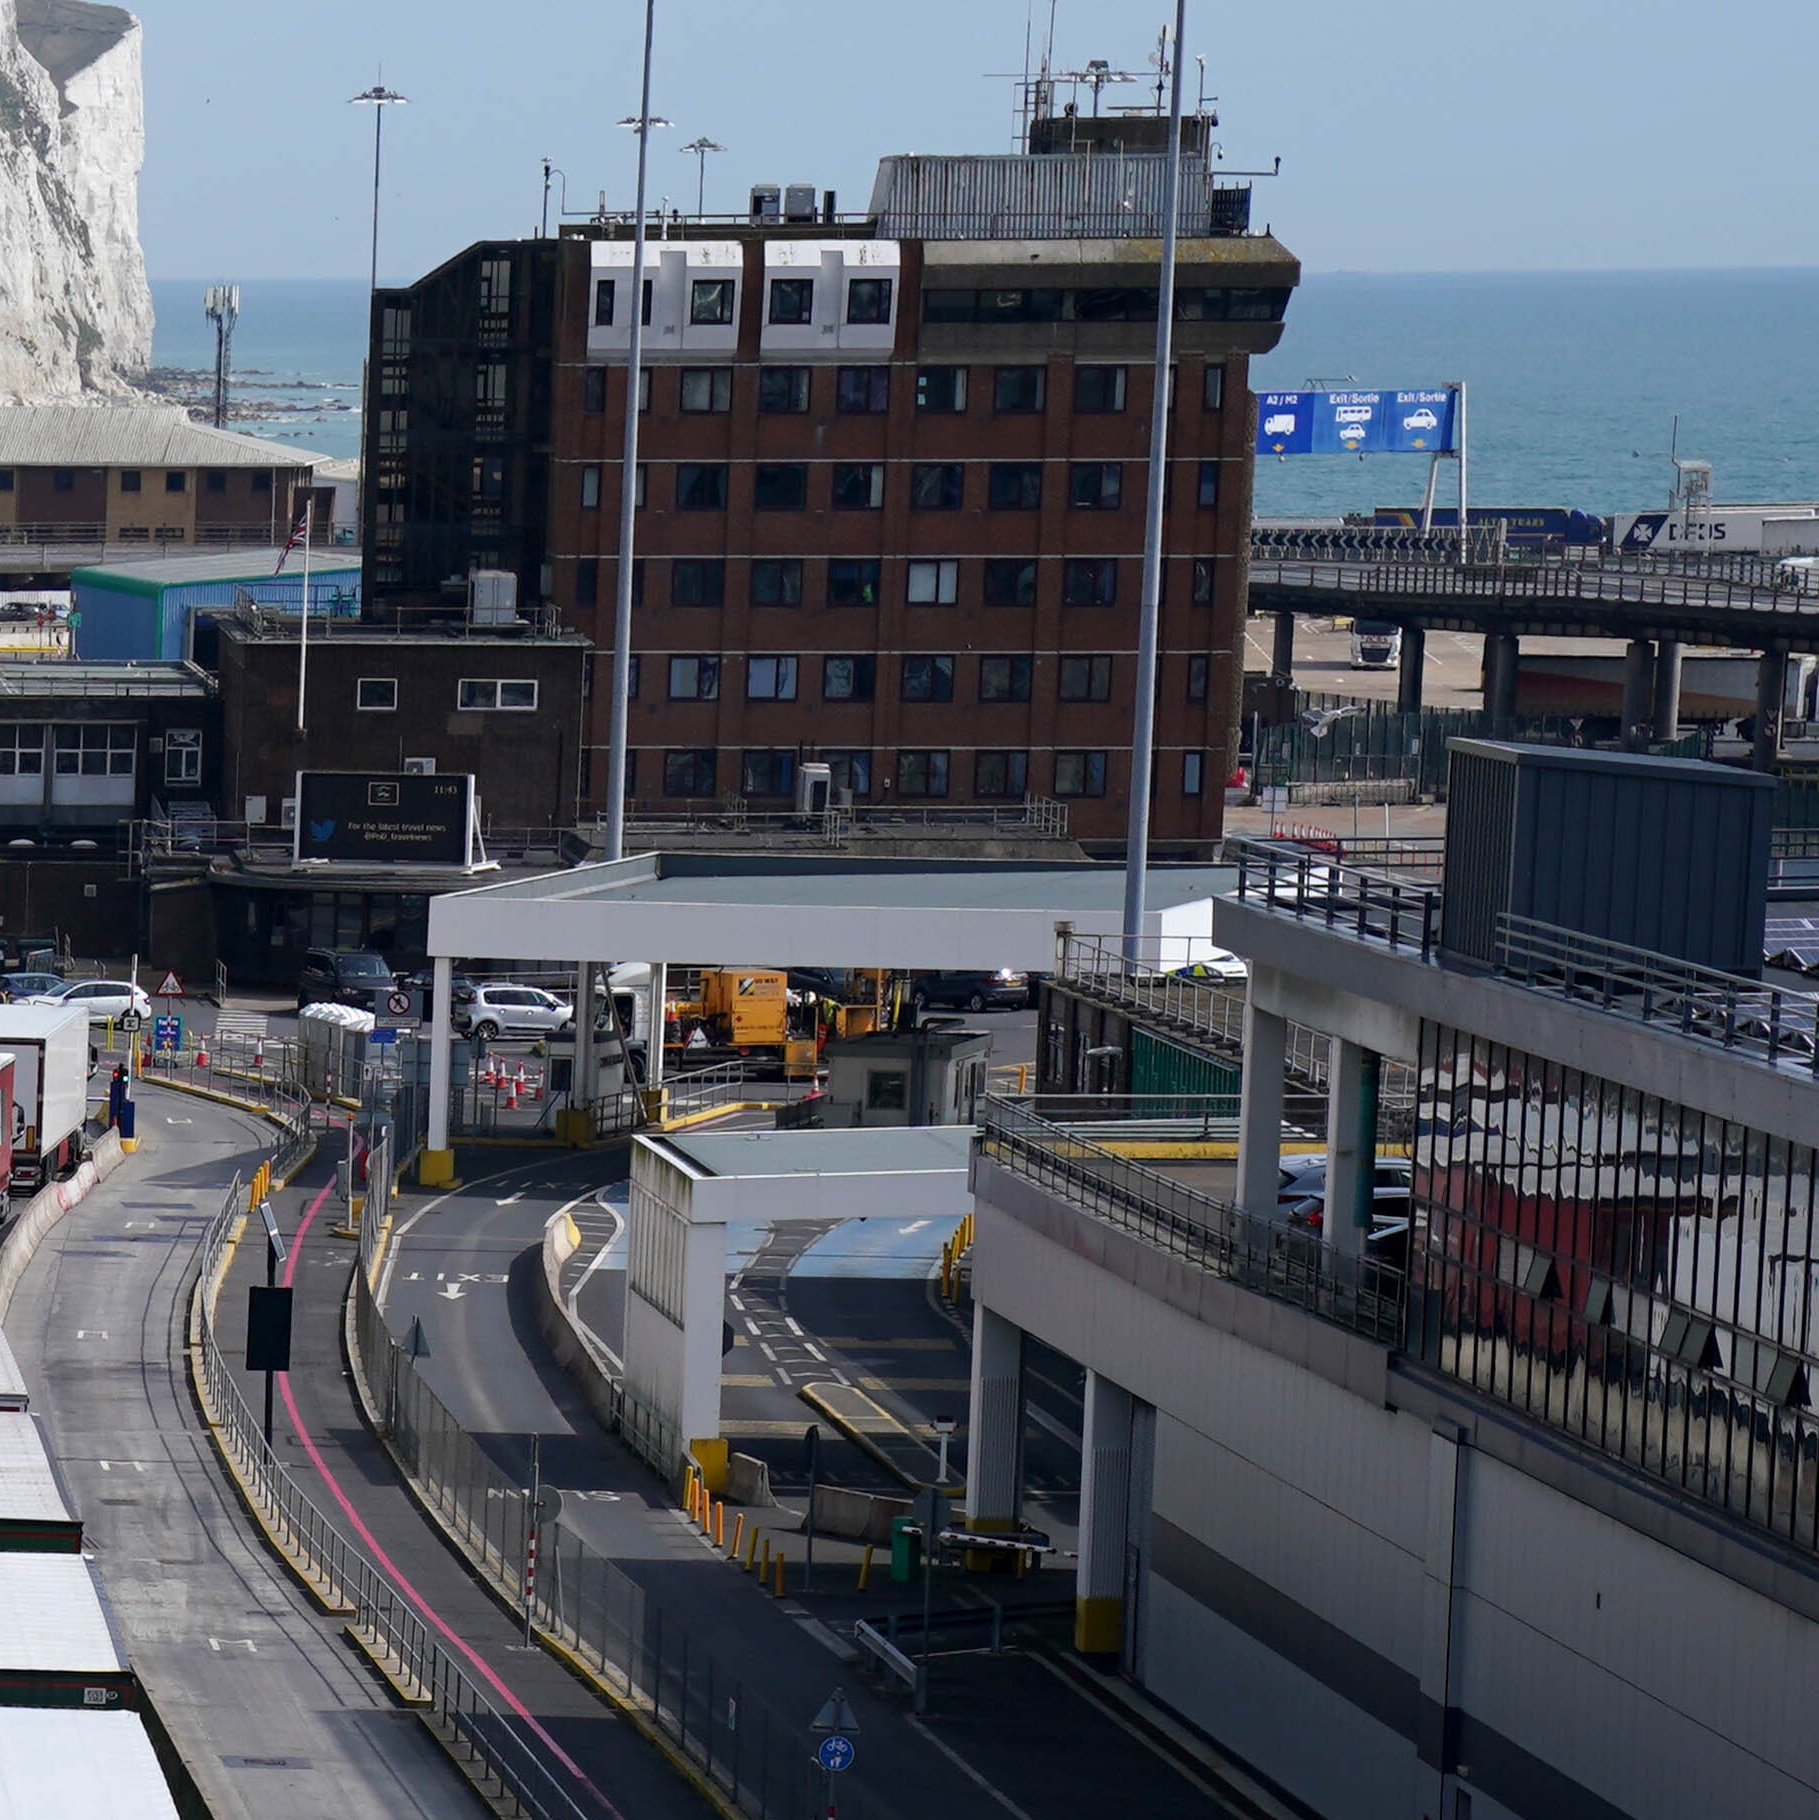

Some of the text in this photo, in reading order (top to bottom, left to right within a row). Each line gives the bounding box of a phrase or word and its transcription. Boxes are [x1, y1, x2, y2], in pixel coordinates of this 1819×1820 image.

[1267, 395, 1279, 404] A2
[1329, 393, 1379, 405] Exit/Sortie
[1397, 392, 1446, 404] Exit/Sortie
[363, 822, 375, 831] the
[378, 822, 401, 832] latest
[402, 822, 423, 832] travel
